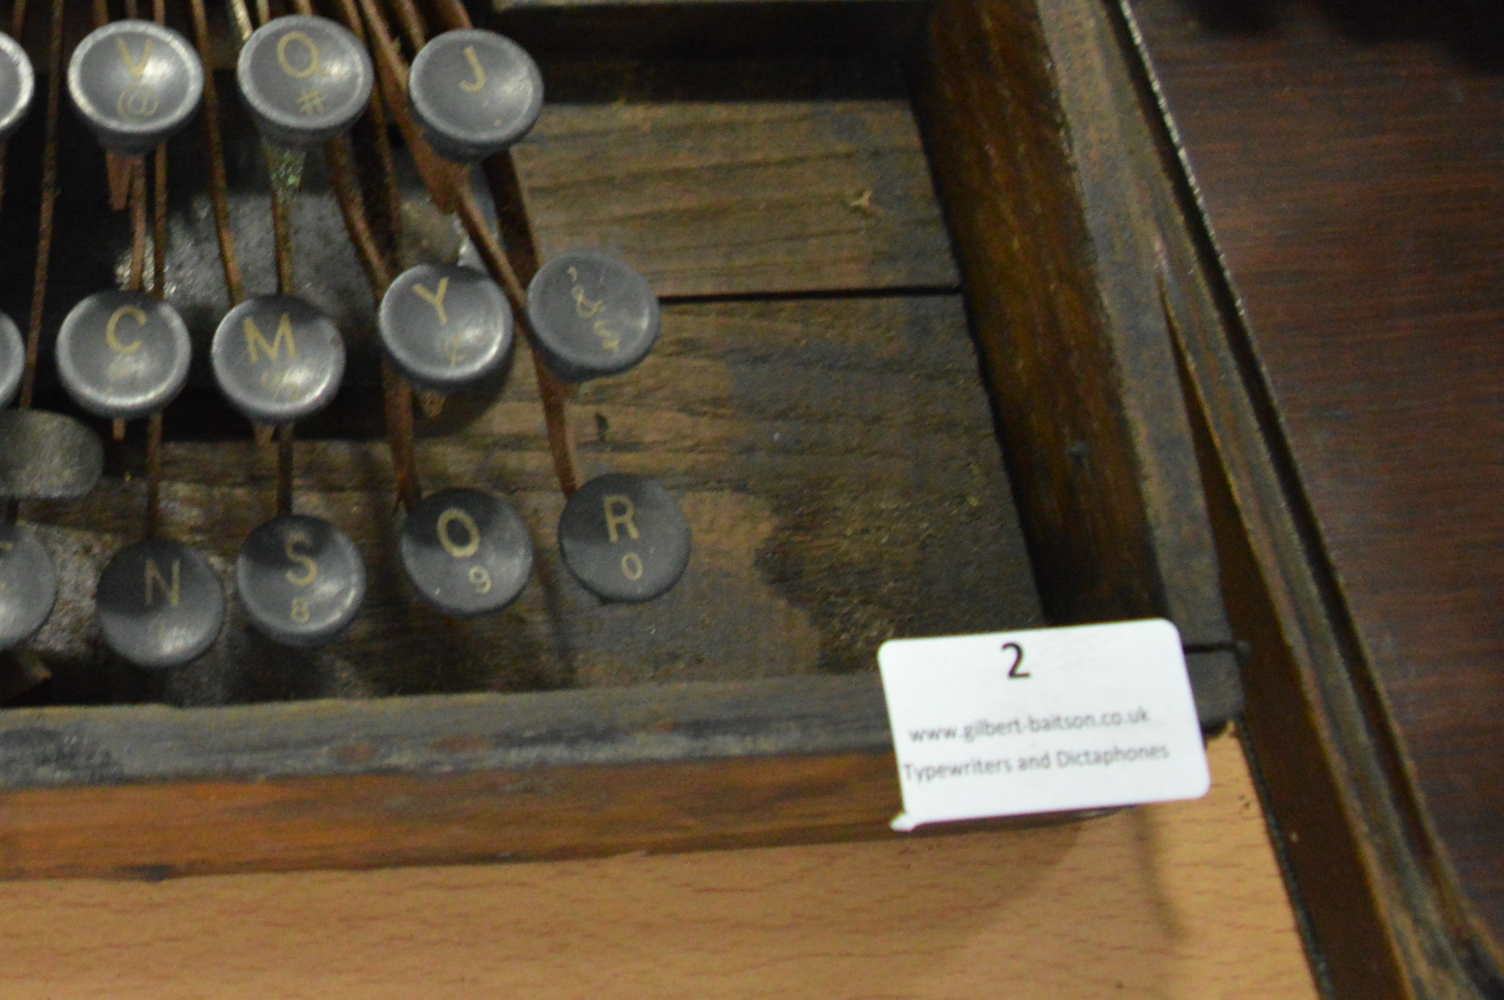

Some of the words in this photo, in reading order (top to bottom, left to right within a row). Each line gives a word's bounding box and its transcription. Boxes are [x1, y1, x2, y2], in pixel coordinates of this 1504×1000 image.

[118, 38, 154, 78] V
[459, 45, 486, 93] J
[413, 276, 449, 326] Y
[106, 305, 148, 354] C
[244, 313, 296, 364] M
[436, 507, 480, 558] O
[603, 495, 639, 544] R
[285, 526, 319, 587] S
[468, 566, 493, 594] 9
[144, 555, 181, 608] N
[1002, 642, 1031, 678] 2
[908, 706, 1149, 742] www.gilbert-baitson.co.uk
[903, 757, 1012, 782] Typewriters
[1018, 753, 1051, 770] and
[1057, 743, 1170, 768] Dictaphones
